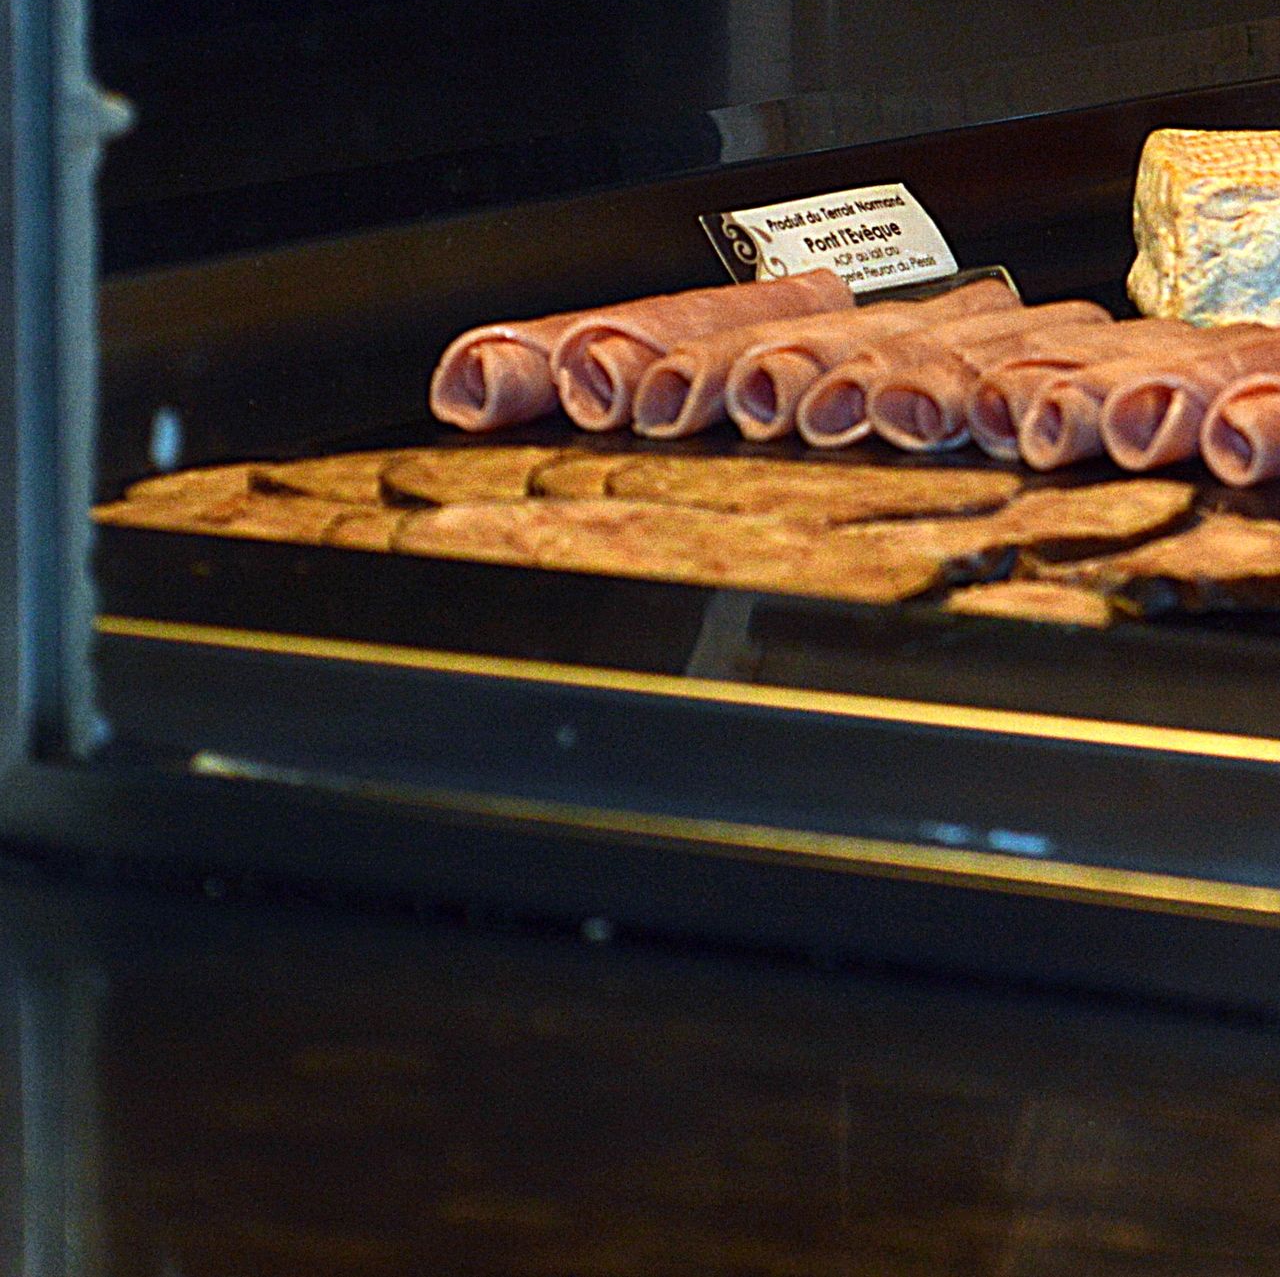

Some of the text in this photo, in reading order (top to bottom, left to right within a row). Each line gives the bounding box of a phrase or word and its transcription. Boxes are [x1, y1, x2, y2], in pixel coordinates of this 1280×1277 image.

[766, 194, 906, 234] Produit du Terroir Normand
[803, 234, 841, 254] Pont
